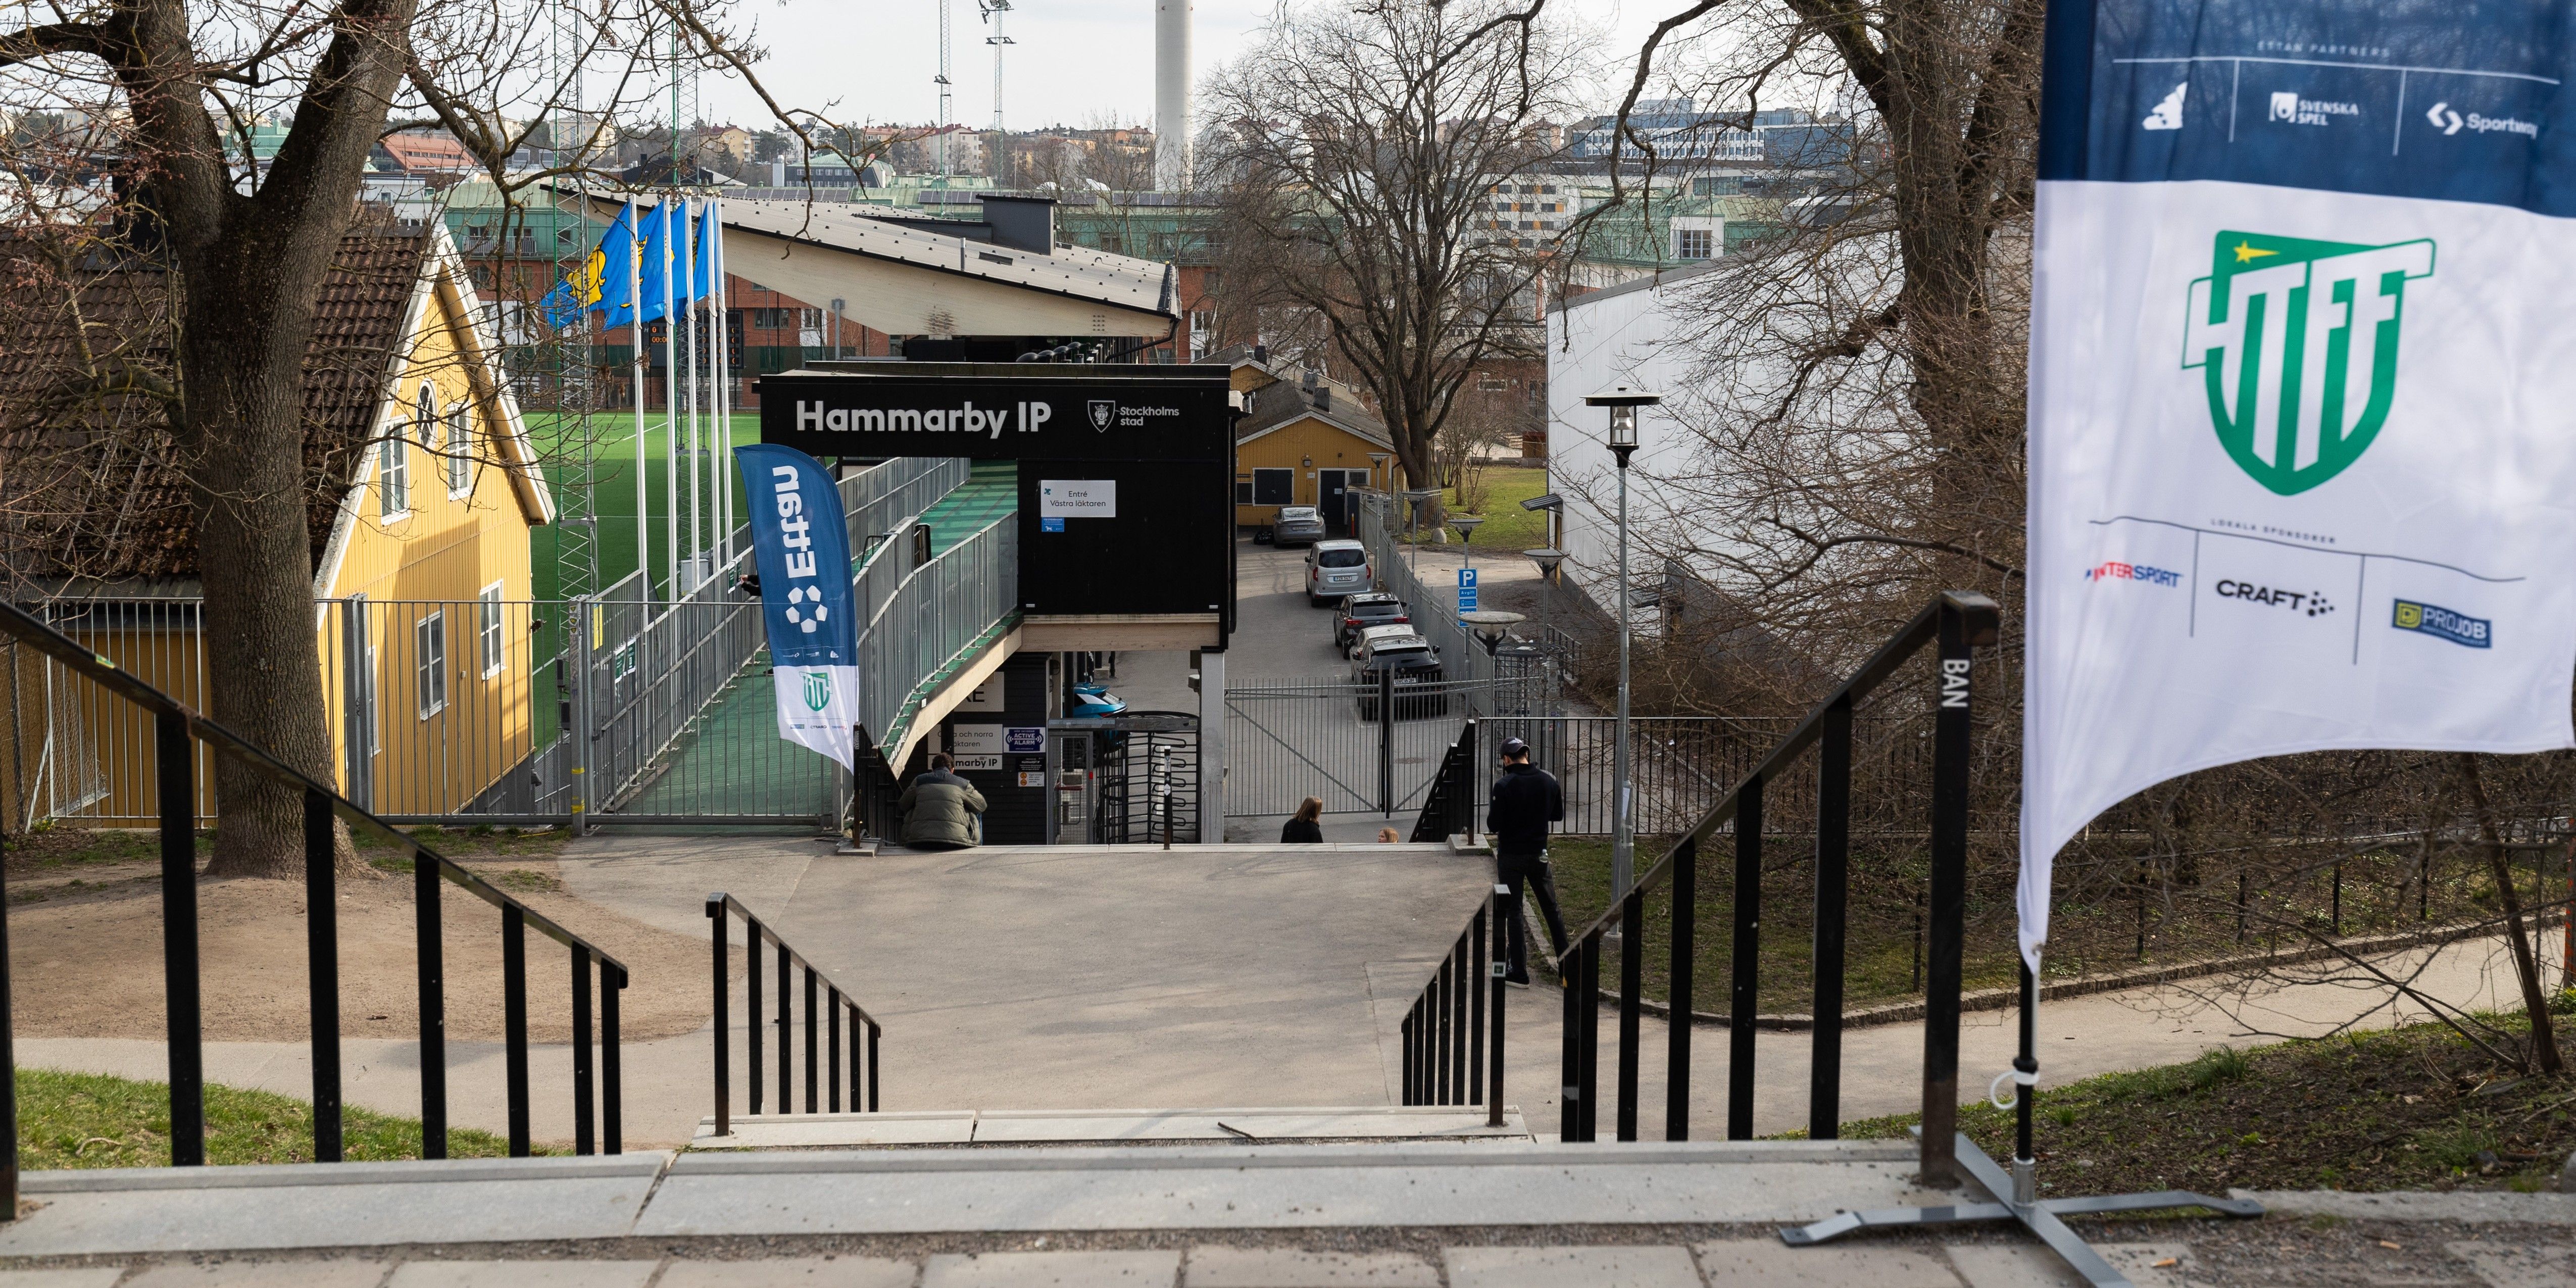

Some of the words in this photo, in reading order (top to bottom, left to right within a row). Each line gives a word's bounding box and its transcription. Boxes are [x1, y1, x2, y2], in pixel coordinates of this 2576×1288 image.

[2256, 40, 2304, 53] ETTAN
[2309, 43, 2391, 58] PARTNERS
[2298, 99, 2359, 116] SVENSKA
[2297, 111, 2329, 126] SPEL
[2466, 112, 2538, 140] Sportway
[796, 400, 1008, 439] Hammarby
[1017, 401, 1052, 432] IP
[1119, 406, 1180, 417] Stockholms
[1120, 416, 1144, 426] stad
[1068, 490, 1088, 498] Entré
[1050, 499, 1073, 507] Västra
[1075, 499, 1106, 507] läktaren
[2210, 518, 2257, 531] LOKALA
[2263, 526, 2336, 543] SPONSORER
[1463, 570, 1474, 586] P
[2093, 561, 2183, 587] INTERSPORT
[2216, 578, 2306, 611] CRAFT
[2422, 607, 2487, 639] PROJOB
[1941, 659, 1971, 708] BAN
[955, 757, 986, 768] marby
[988, 758, 998, 766] IP
